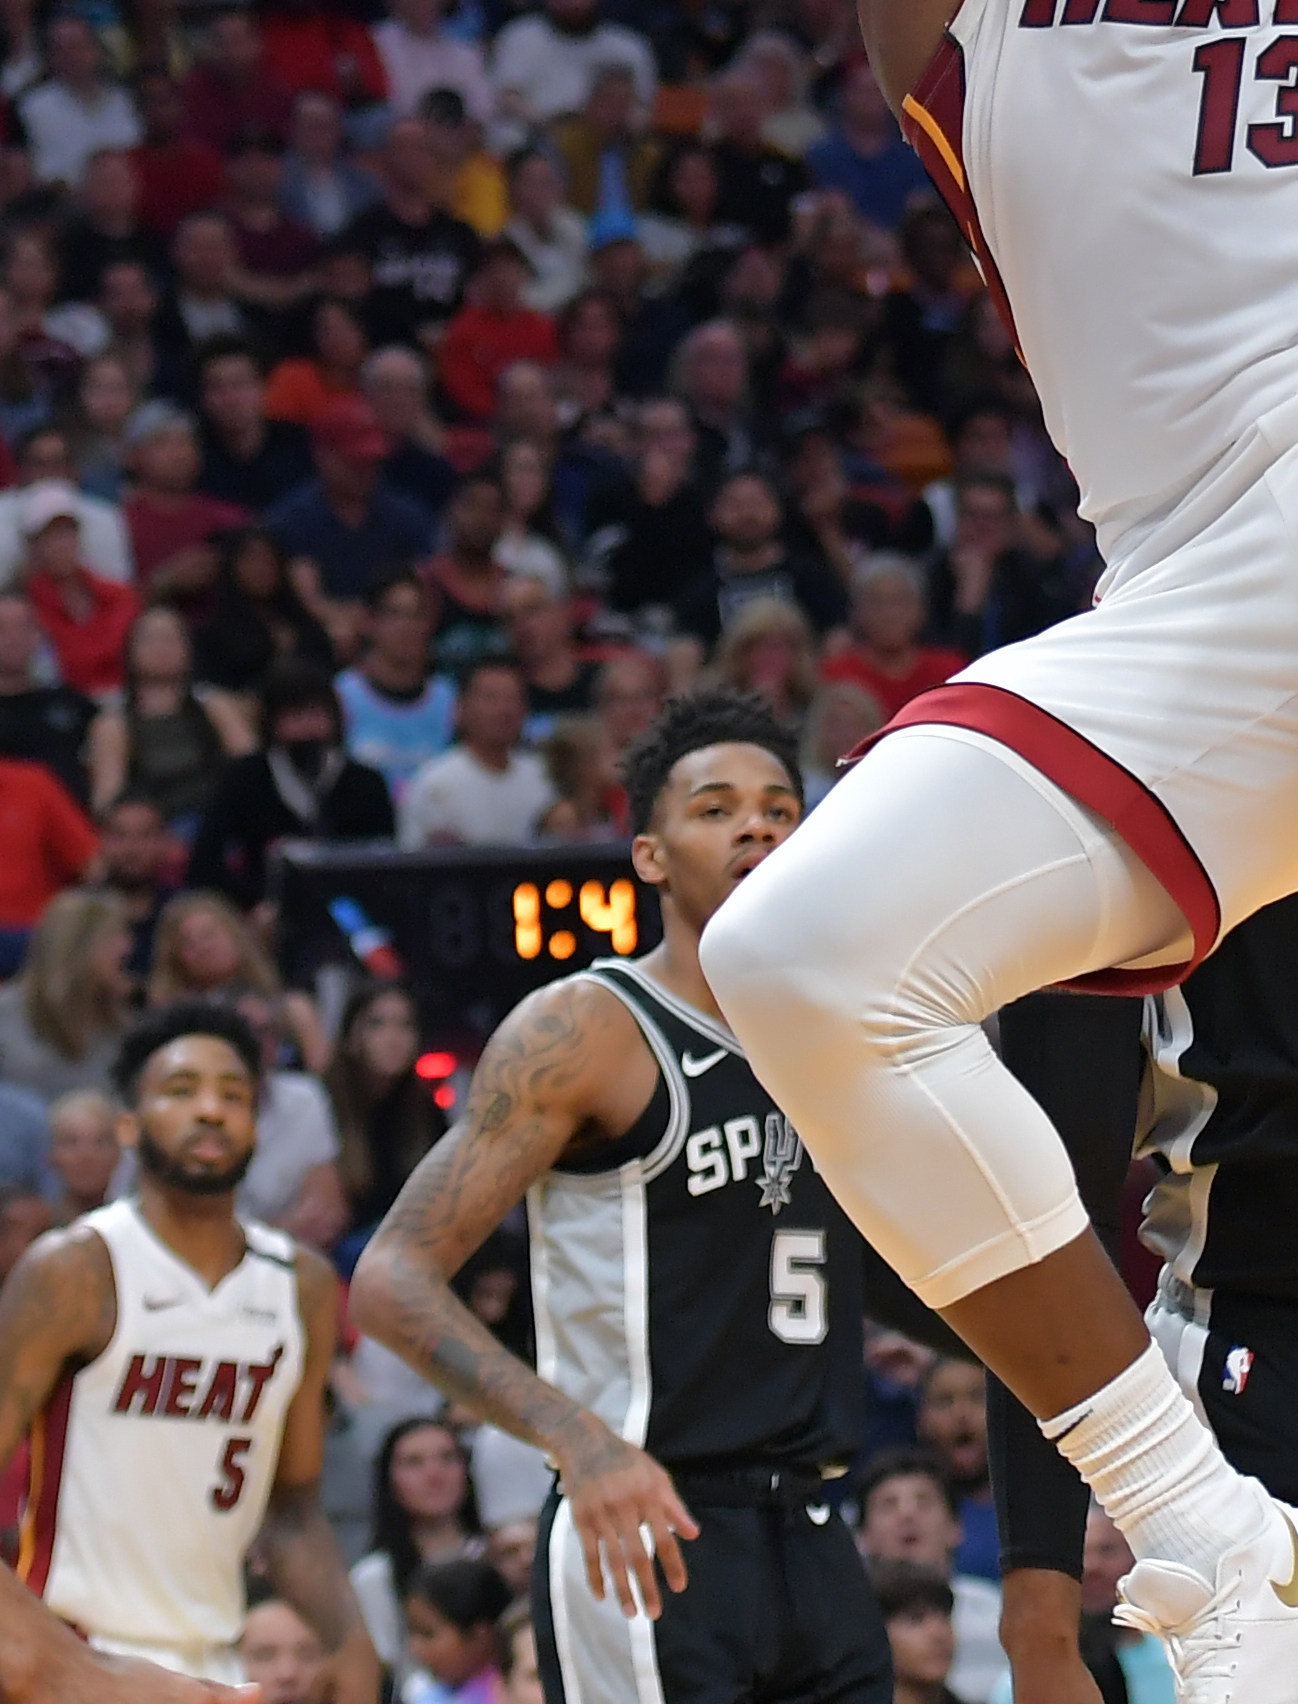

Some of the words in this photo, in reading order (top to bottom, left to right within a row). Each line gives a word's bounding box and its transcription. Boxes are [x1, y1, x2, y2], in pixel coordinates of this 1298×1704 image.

[767, 1228, 829, 1346] 5
[112, 1342, 284, 1423] HEAT
[211, 1438, 251, 1511] 5
